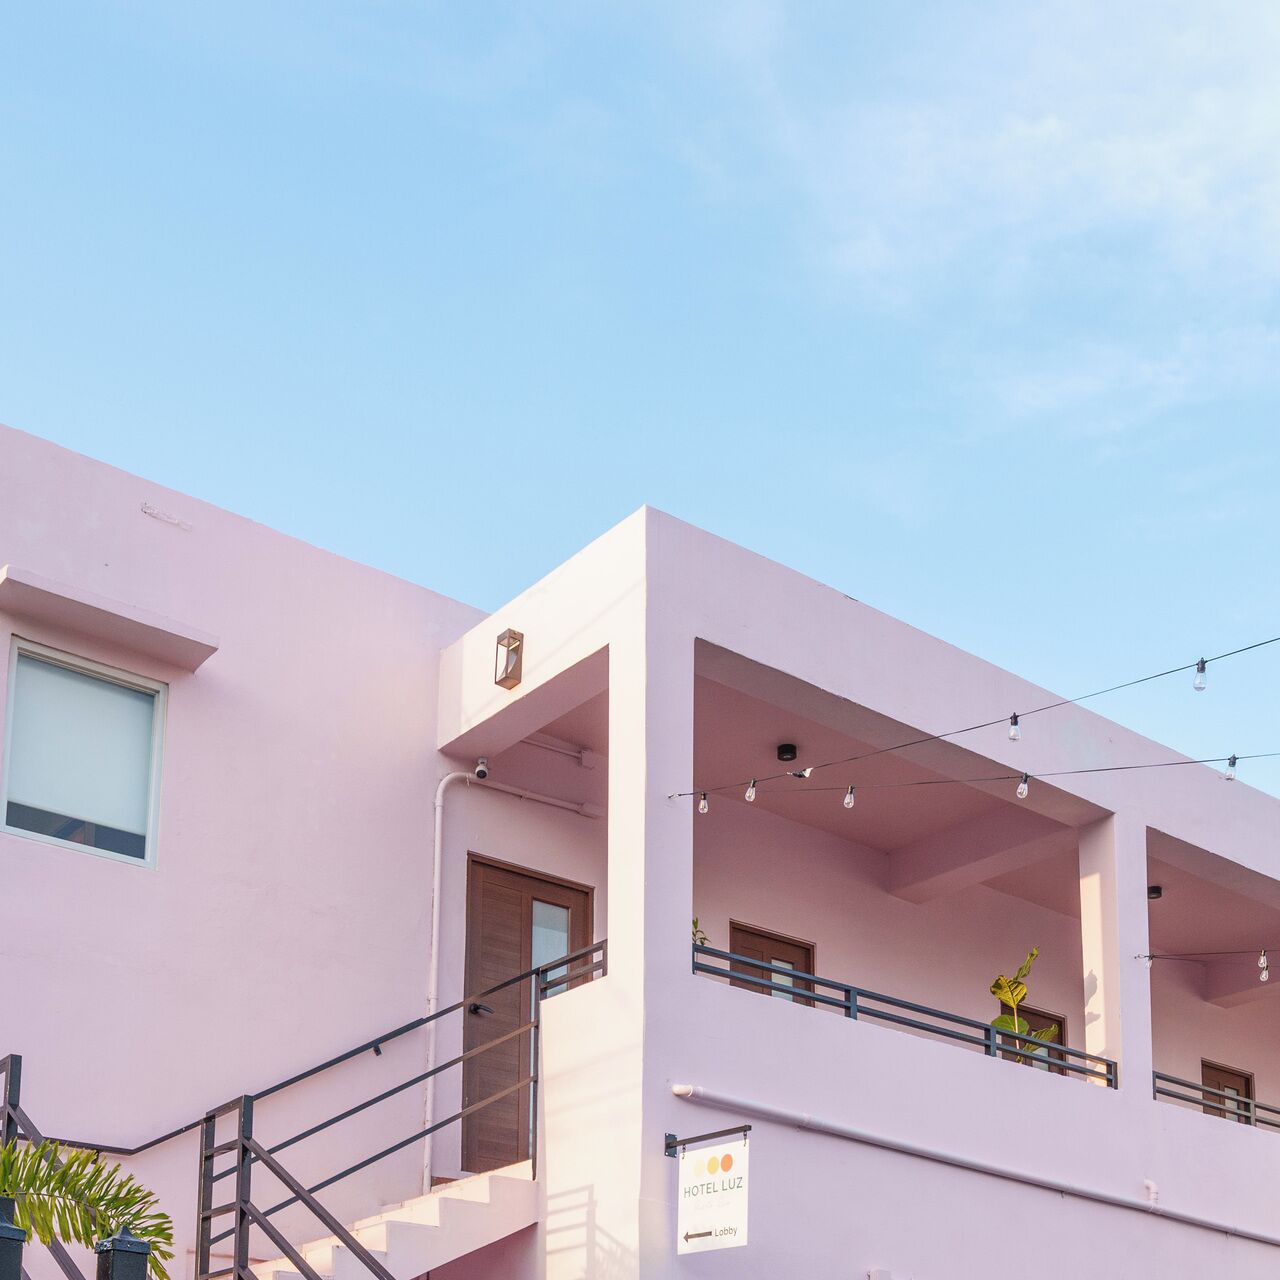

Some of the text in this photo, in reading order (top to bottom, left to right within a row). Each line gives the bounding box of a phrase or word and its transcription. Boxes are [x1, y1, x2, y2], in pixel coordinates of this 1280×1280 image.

[684, 1177, 743, 1198] HOTEL LUZ
[714, 1226, 738, 1237] Lobby
